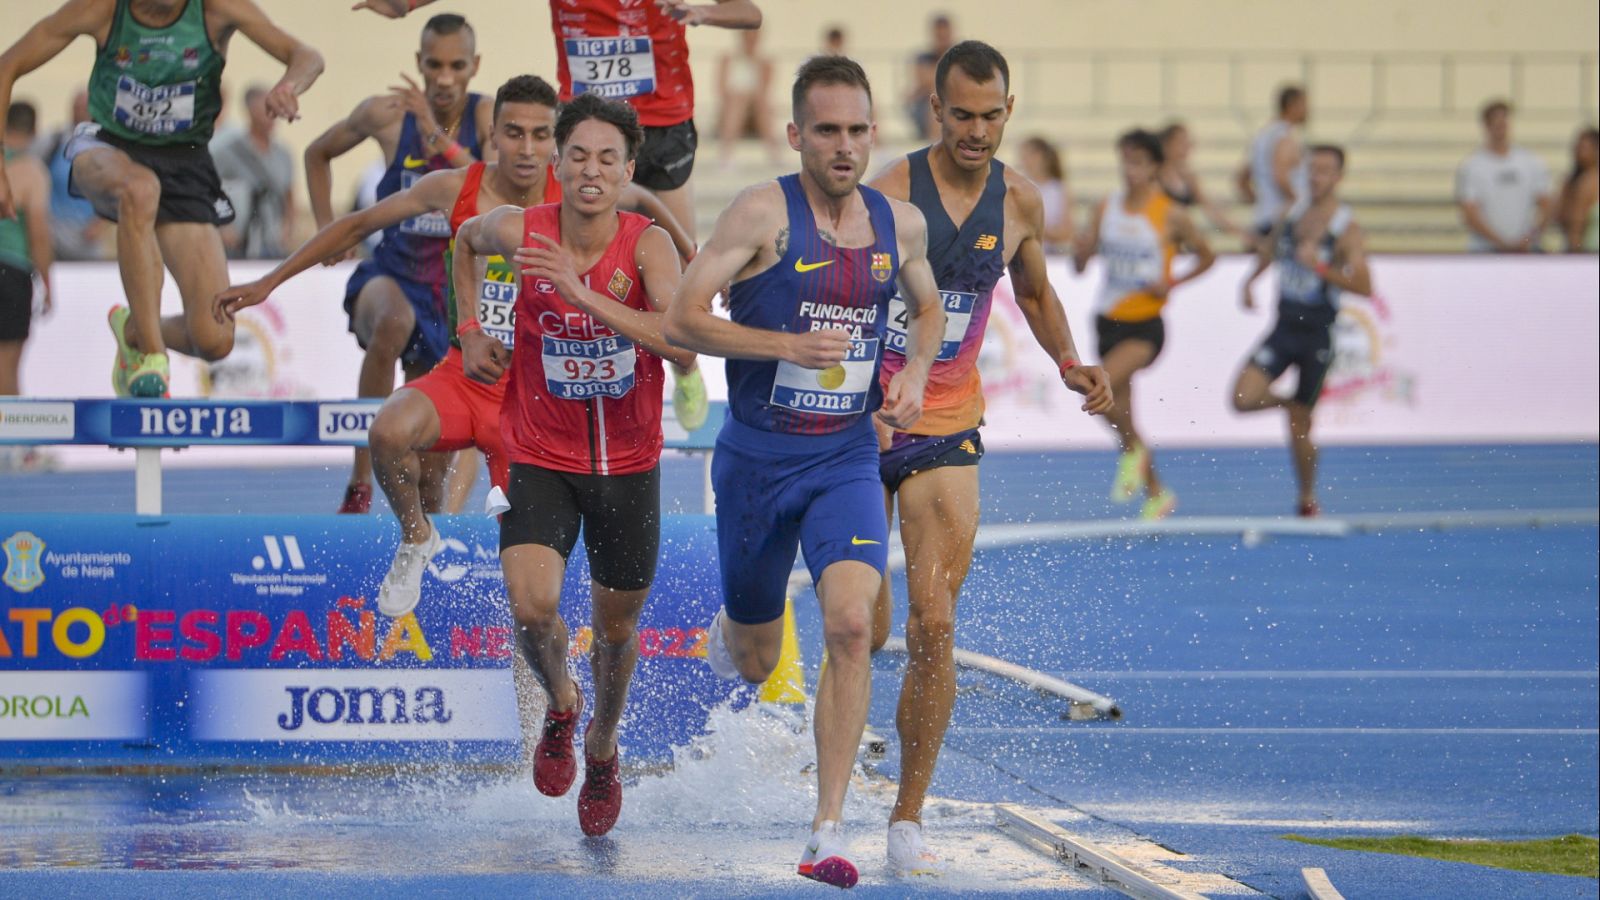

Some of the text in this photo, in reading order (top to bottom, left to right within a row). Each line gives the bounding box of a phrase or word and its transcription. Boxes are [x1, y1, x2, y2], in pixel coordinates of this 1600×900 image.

[577, 38, 637, 56] nerja
[585, 57, 632, 80] 378
[132, 101, 172, 120] 452
[799, 301, 877, 324] FUNDACIÓ
[553, 337, 618, 358] nerja
[564, 359, 616, 380] 923
[4, 413, 69, 425] IBERDROLA
[139, 406, 252, 438] nerja
[45, 550, 132, 568] Ayuntamiento
[61, 564, 115, 581] de Nerja
[0, 607, 106, 659] TO
[135, 595, 433, 662] ESPAÑA
[637, 625, 709, 658] 022
